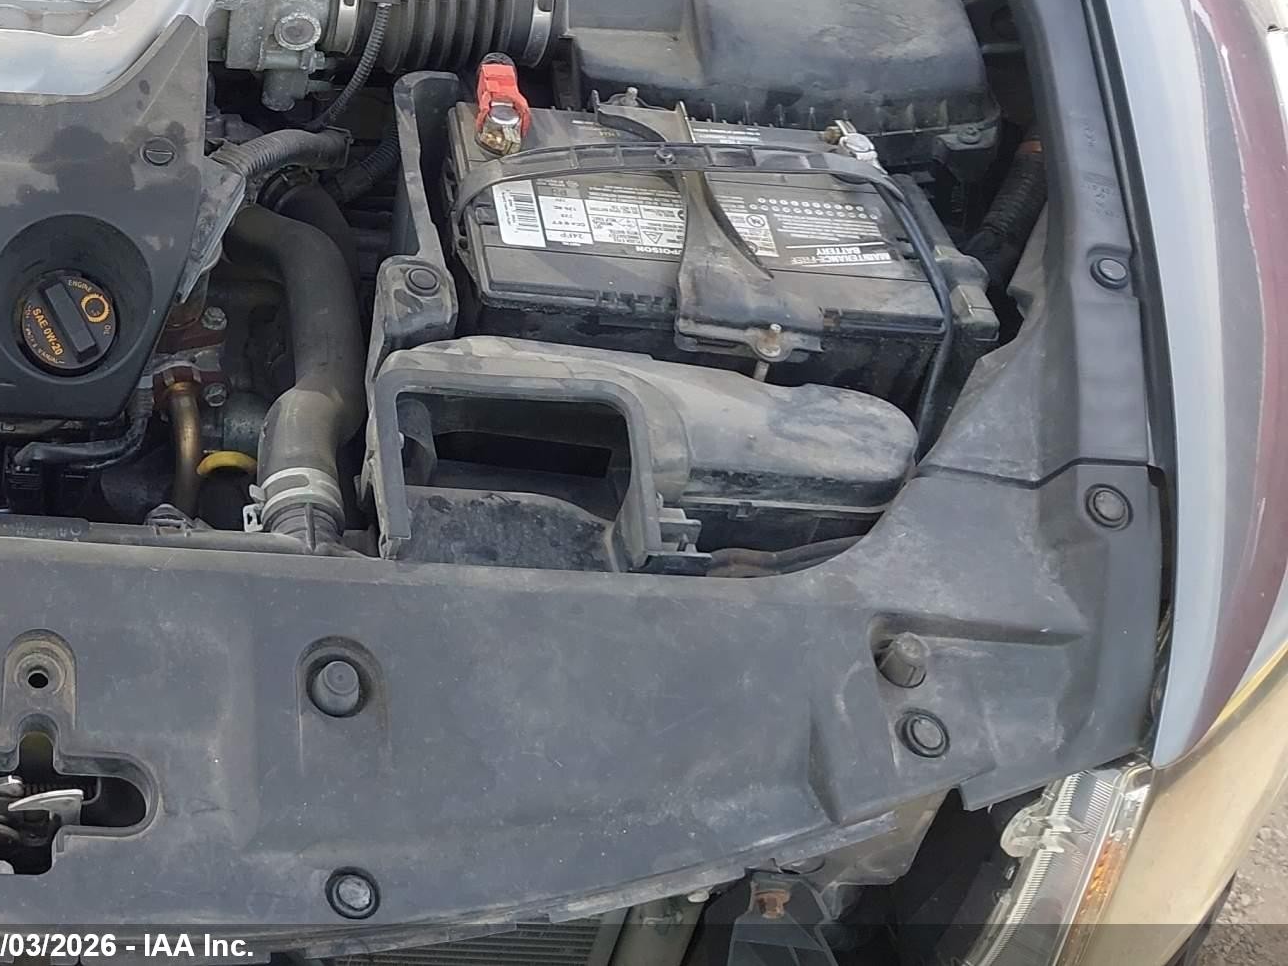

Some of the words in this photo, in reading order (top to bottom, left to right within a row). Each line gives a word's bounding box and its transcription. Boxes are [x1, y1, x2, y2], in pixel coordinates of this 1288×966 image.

[815, 246, 862, 256] BATTERY
[32, 307, 48, 329] SAE
[43, 328, 64, 356] 0W-20
